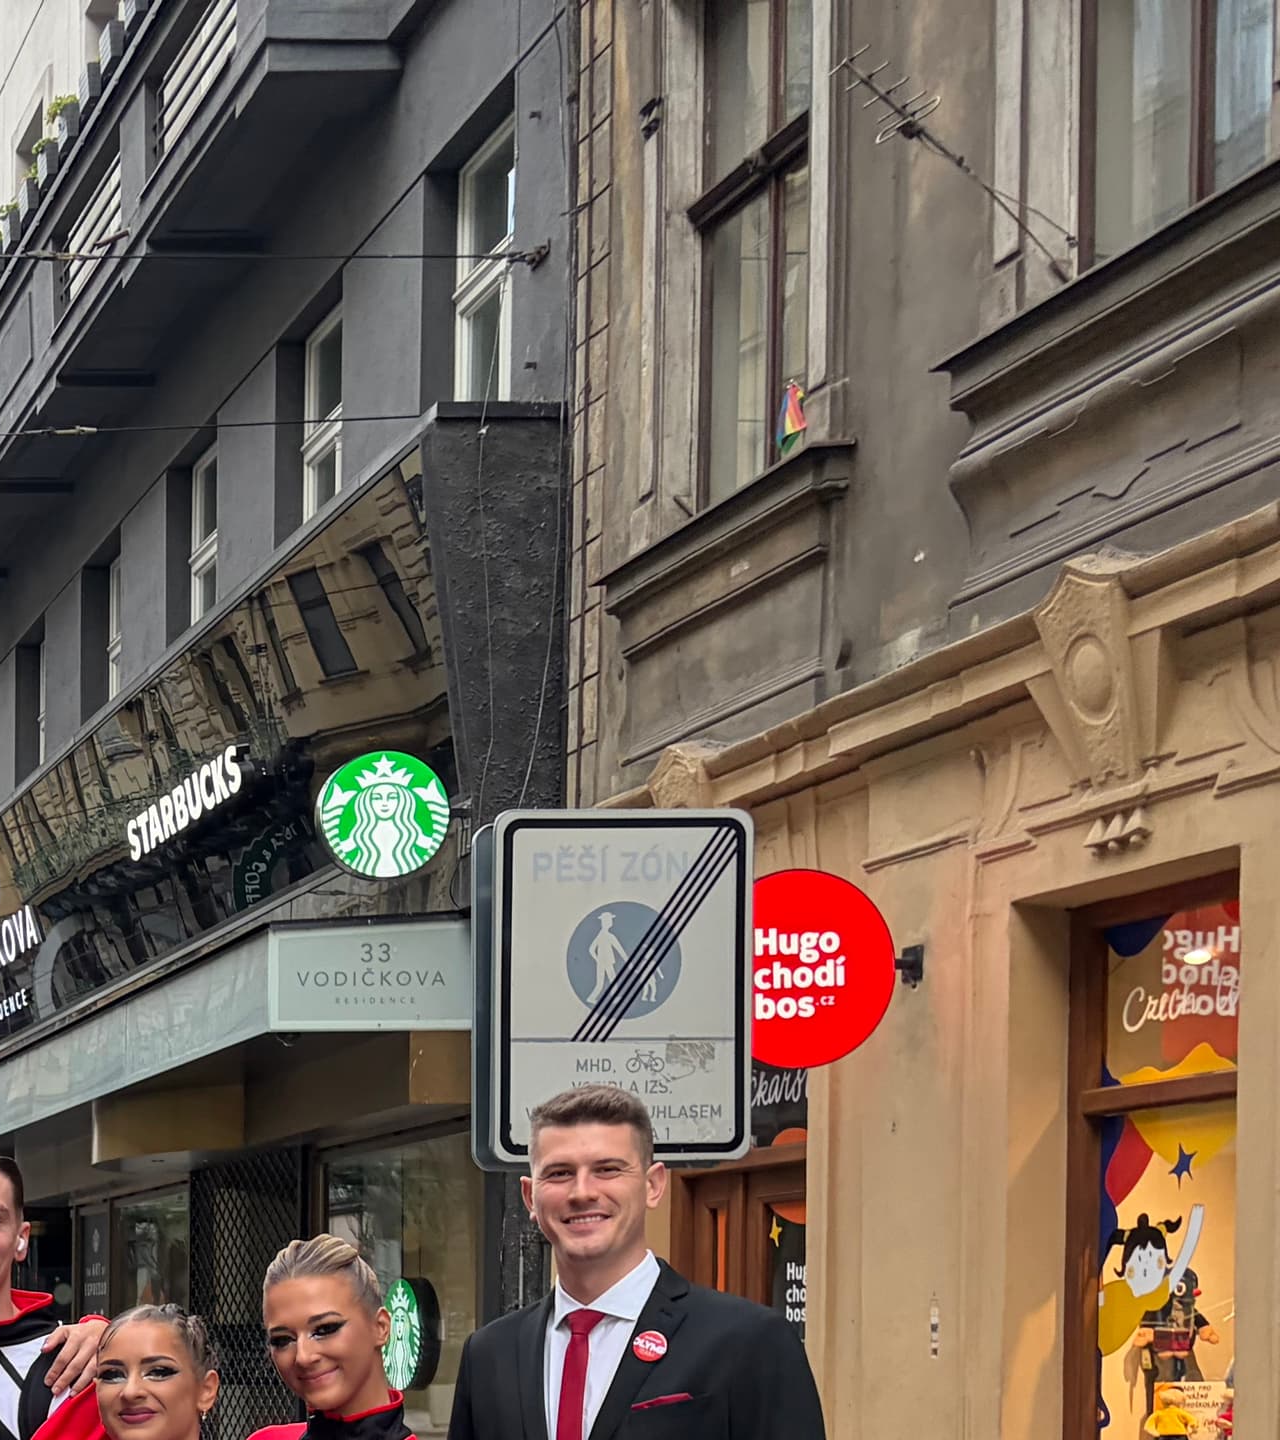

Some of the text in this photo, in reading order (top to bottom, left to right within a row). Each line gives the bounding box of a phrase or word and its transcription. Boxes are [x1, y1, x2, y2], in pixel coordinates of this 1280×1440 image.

[127, 745, 242, 862] STARBUCKS
[532, 844, 694, 883] PĚŠÍ ZÓN
[360, 943, 391, 963] 33
[754, 928, 840, 963] Hugo
[297, 968, 446, 988] VODIČKOVA
[754, 956, 846, 989] chodí
[576, 1059, 617, 1074] MHD,
[650, 1105, 723, 1119] UHLASEM
[786, 1284, 807, 1303] cho
